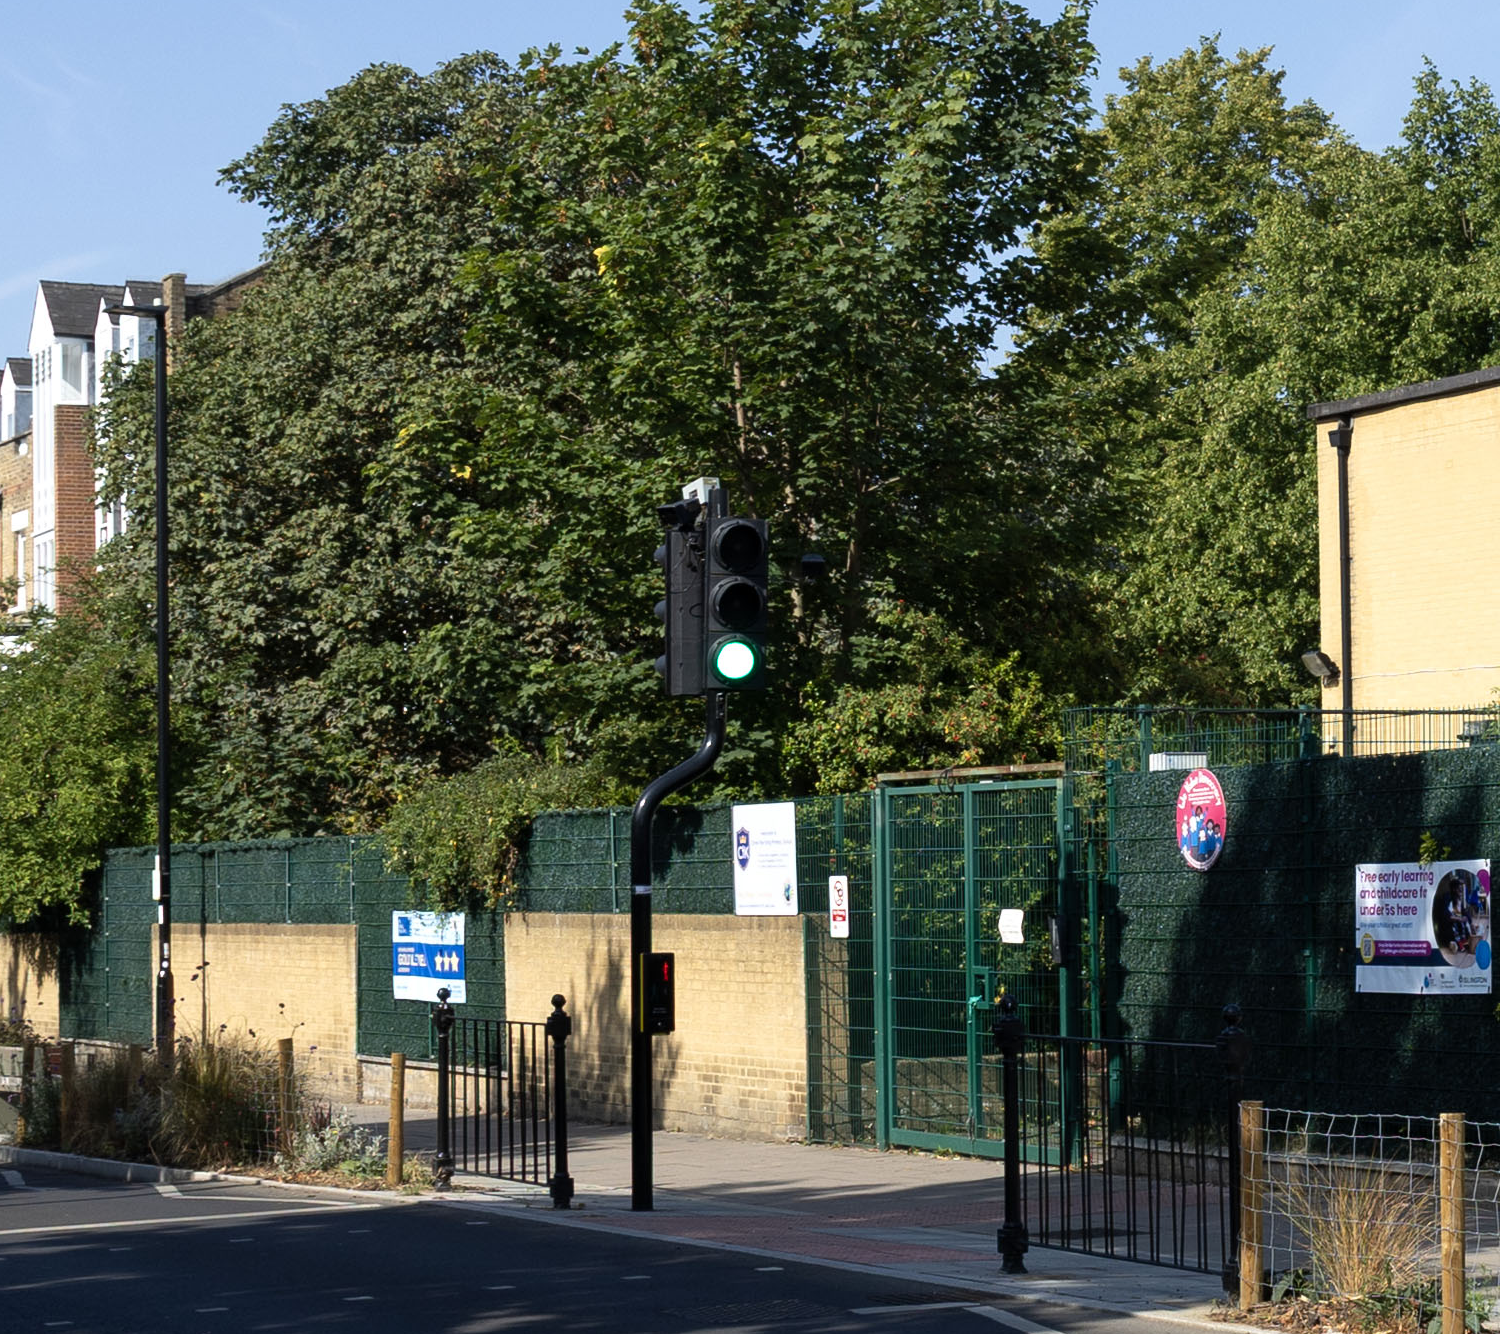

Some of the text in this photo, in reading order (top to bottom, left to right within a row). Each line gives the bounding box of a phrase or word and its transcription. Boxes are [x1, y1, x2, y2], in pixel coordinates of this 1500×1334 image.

[1360, 870, 1377, 883] Free
[1378, 869, 1400, 886] early
[1376, 886, 1418, 899] childcare
[1360, 903, 1418, 916] under 5s here
